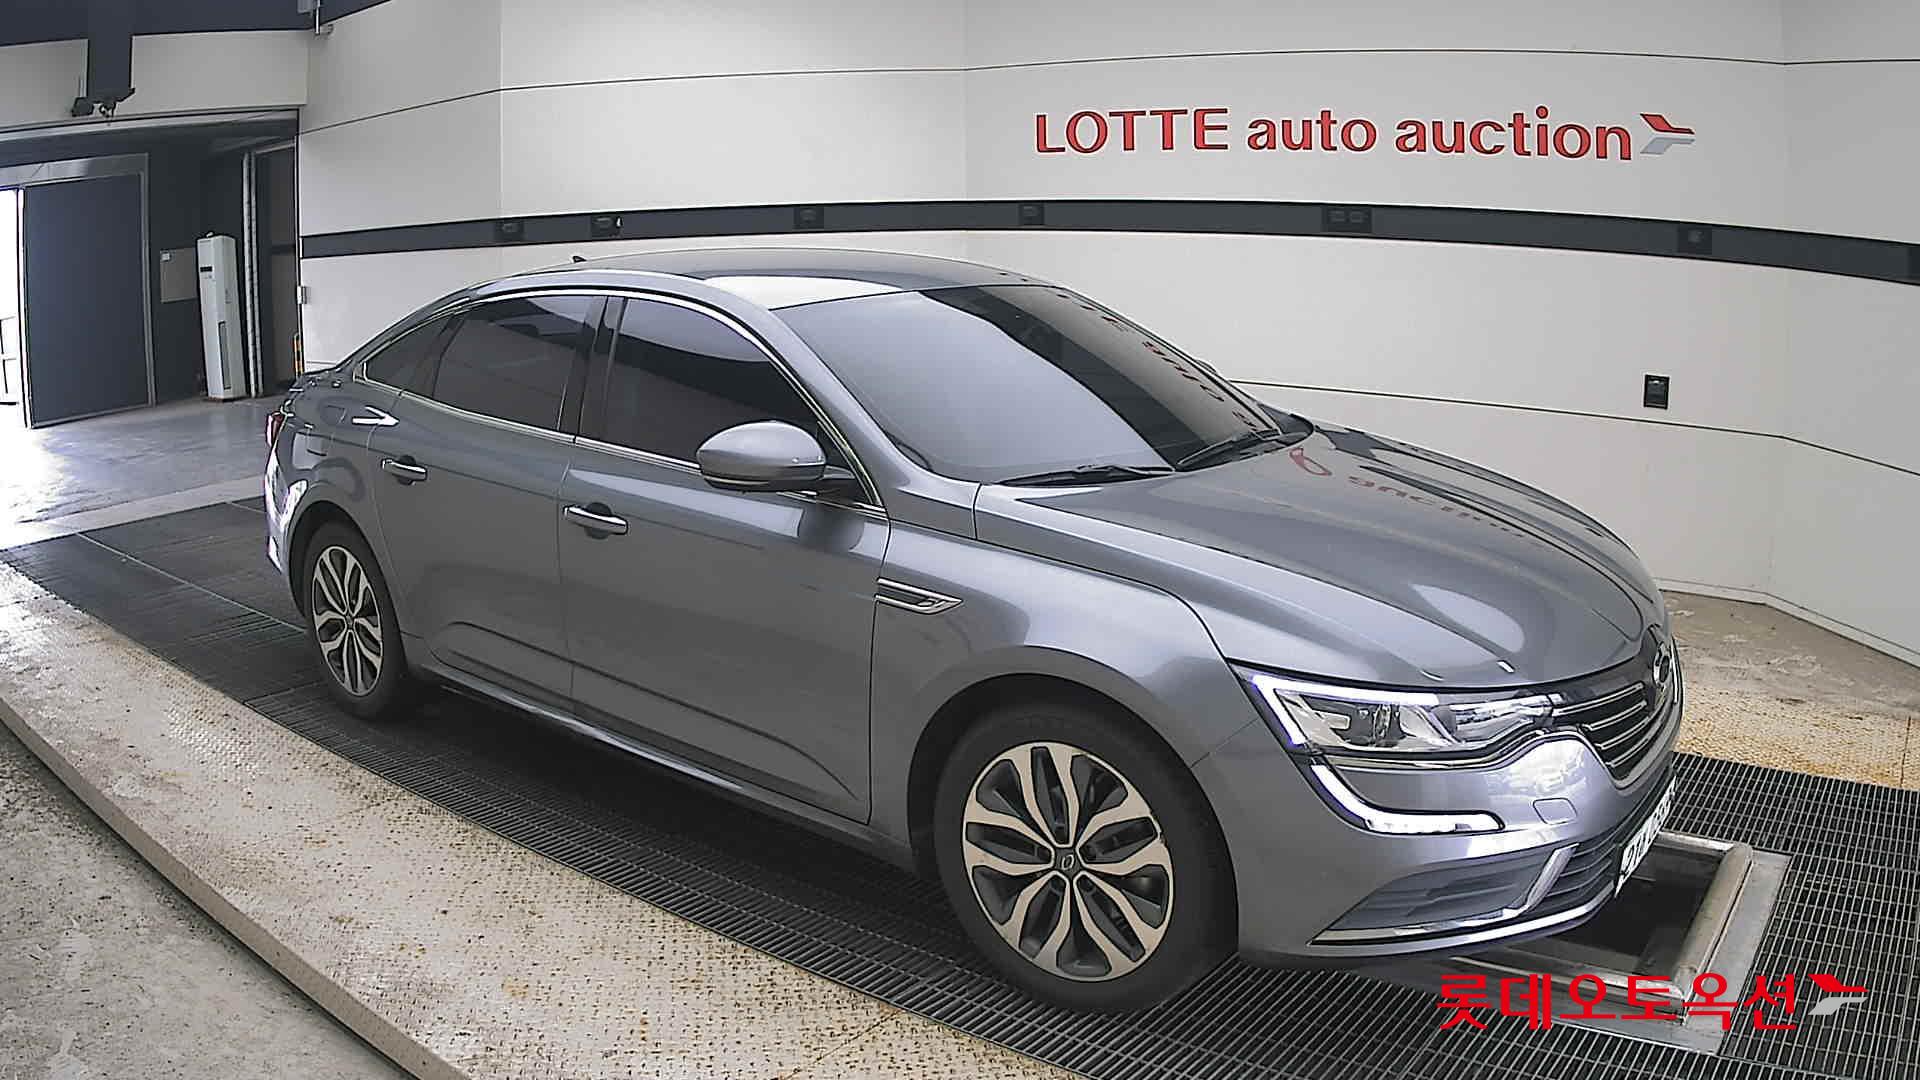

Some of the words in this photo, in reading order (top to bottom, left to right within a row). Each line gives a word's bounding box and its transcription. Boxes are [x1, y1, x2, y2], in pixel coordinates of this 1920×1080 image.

[1036, 108, 1228, 153] LOTTE
[1247, 111, 1377, 151] auto
[1395, 107, 1632, 160] auction
